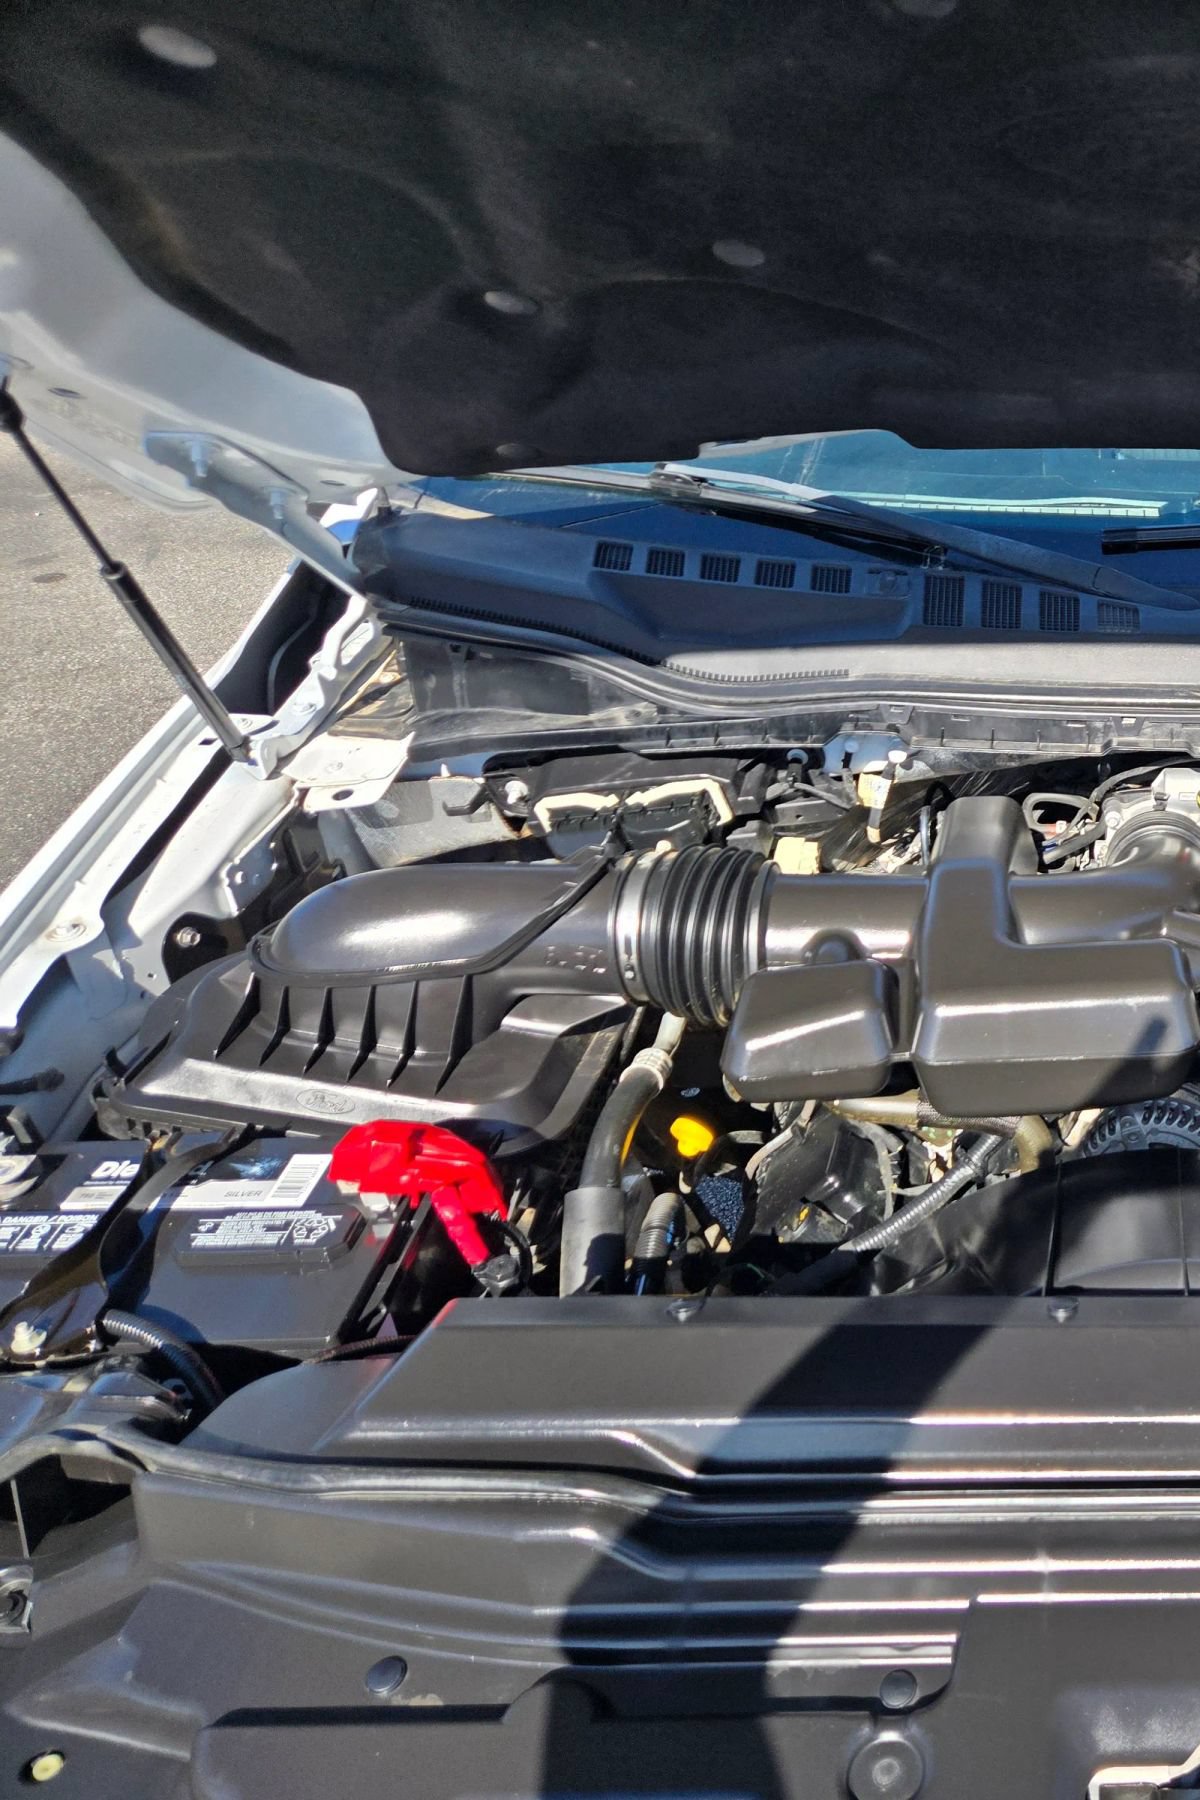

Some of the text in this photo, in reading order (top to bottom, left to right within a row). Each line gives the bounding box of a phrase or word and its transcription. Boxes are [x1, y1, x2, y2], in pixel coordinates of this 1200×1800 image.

[304, 1090, 348, 1112] Ford
[224, 1190, 263, 1198] SILVER
[4, 1215, 49, 1223] DANGER
